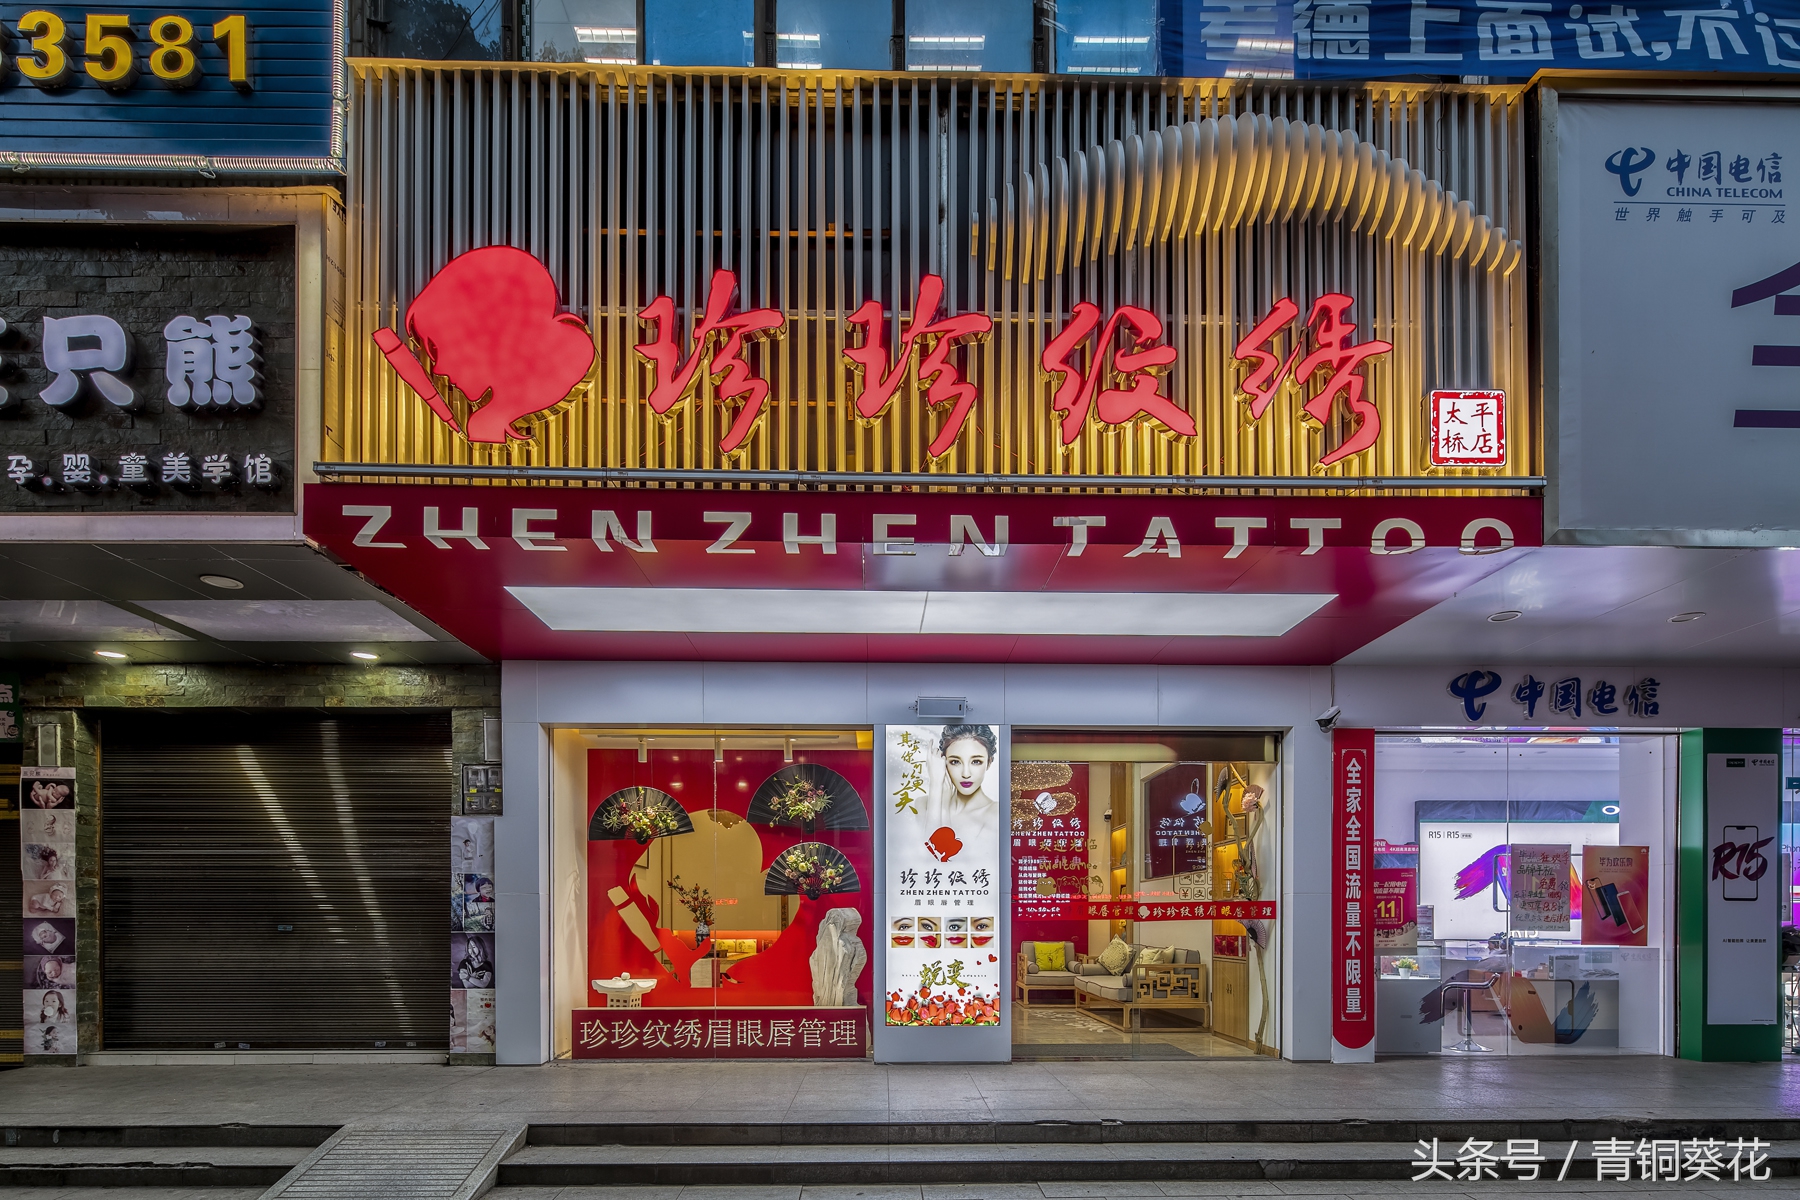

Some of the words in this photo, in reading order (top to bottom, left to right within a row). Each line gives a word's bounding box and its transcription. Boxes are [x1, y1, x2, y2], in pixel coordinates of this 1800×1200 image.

[16, 10, 248, 84] 3581
[1665, 148, 1783, 186] 中国电信
[1614, 207, 1786, 224] 世界触手可及
[1666, 186, 1712, 198] CHINA
[1716, 187, 1783, 199] TELECOM
[0, 315, 257, 407] 只熊
[341, 504, 658, 553] ZHEN
[703, 511, 1009, 557] ZHEN
[1052, 515, 1515, 558] TATTOO
[1510, 674, 1662, 720] 中国电信
[1428, 830, 1442, 839] R15
[1446, 830, 1460, 839] R15
[1711, 836, 1776, 882] R15
[1344, 756, 1363, 1015] 全家全国流量不限量
[579, 1018, 859, 1050] 珍珍纹绣眉眼唇管理
